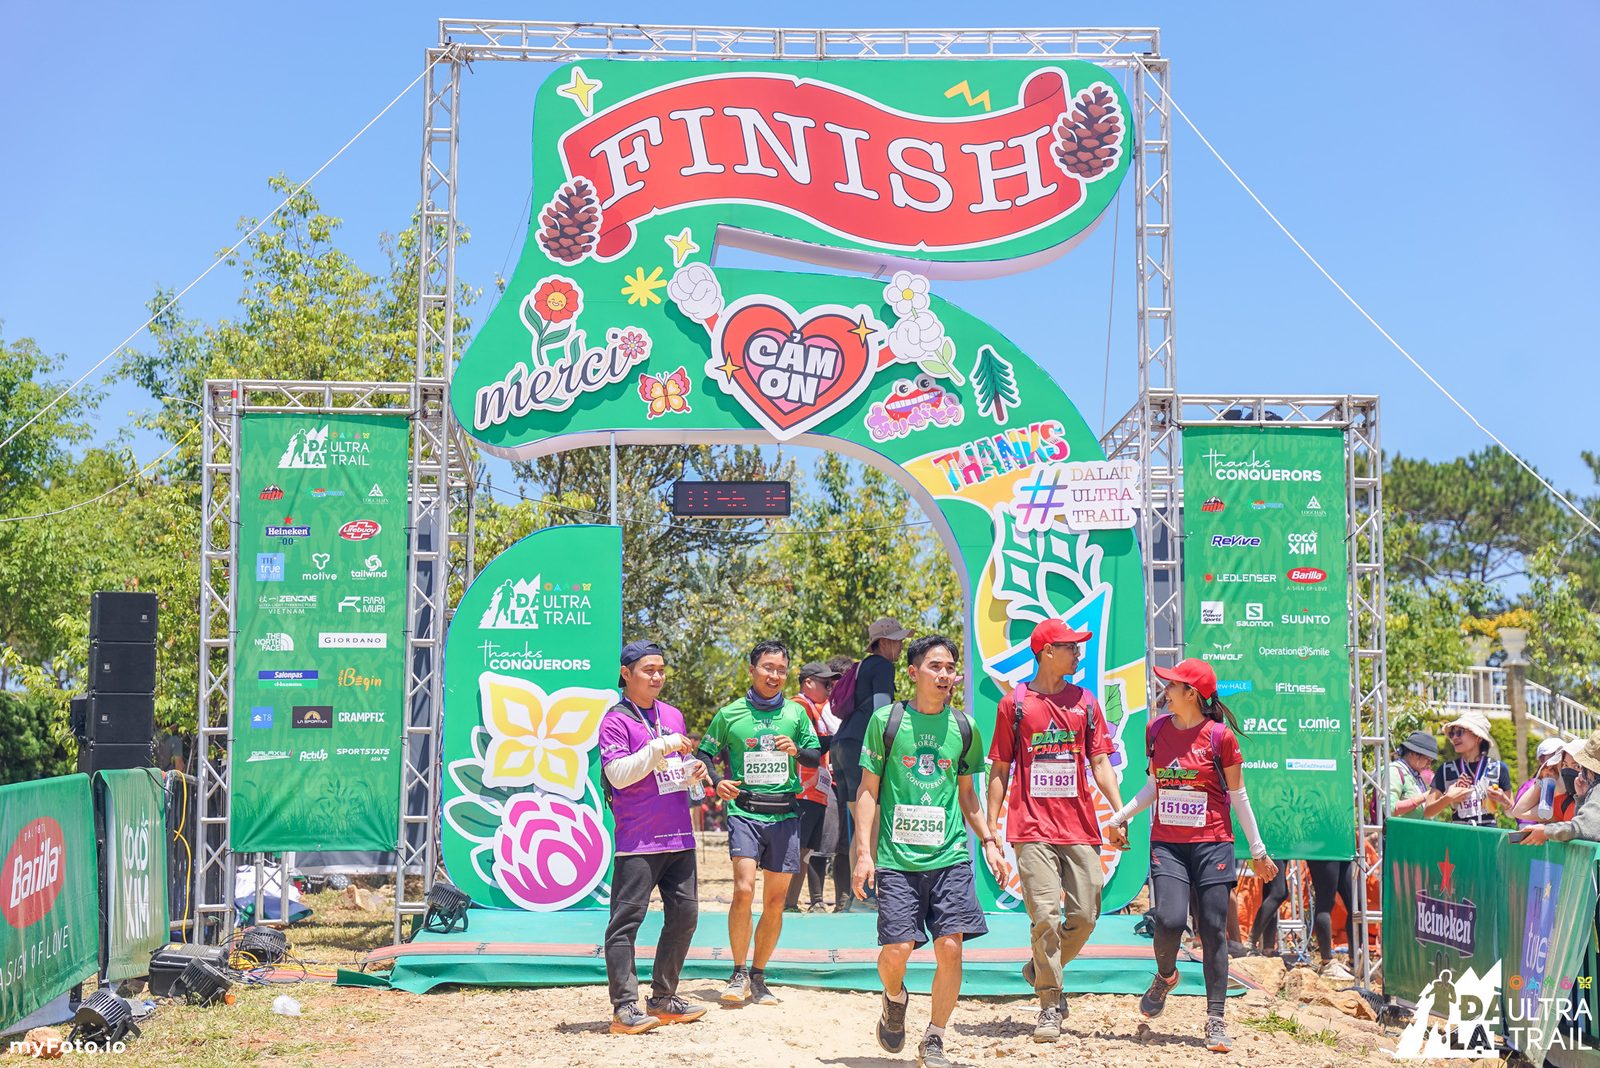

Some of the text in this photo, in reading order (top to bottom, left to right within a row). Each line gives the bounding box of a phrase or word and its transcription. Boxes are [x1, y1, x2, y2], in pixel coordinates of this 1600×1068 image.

[589, 106, 1058, 214] FINISH
[748, 331, 839, 379] CẢM
[479, 332, 634, 426] merci
[330, 441, 370, 453] ULTRA
[331, 454, 370, 466] TRAIL
[933, 422, 1069, 491] THANKS
[1202, 448, 1270, 477] thanks
[1070, 466, 1133, 481] DALAT
[1216, 469, 1322, 482] CONQUERORS
[1072, 488, 1134, 502] ULTRA
[1073, 508, 1130, 523] TRAIL
[268, 527, 308, 536] Heineken
[343, 526, 377, 535] Lifebuoy
[1211, 535, 1261, 547] ReVive
[1288, 543, 1317, 555] XIM
[260, 564, 281, 573] true
[351, 570, 388, 578] tailwind
[302, 572, 337, 580] motive
[1217, 574, 1277, 582] LEDLENSER
[1291, 571, 1322, 580] Barilla
[543, 595, 591, 609] ULTRA
[362, 605, 385, 613] MURI
[543, 611, 591, 625] TRAIL
[1281, 615, 1331, 624] SUUNTO
[477, 639, 542, 666] thanks
[1259, 646, 1330, 657] Operation Smile
[489, 659, 591, 671] CONQUERORS
[274, 671, 303, 679] Salonpas
[1216, 682, 1247, 690] ew-HALE
[338, 712, 385, 722] CRAMPFIX
[1257, 718, 1287, 731] ACC
[912, 740, 944, 751] FOREST
[746, 762, 787, 774] 252329
[1156, 768, 1199, 780] DARE
[906, 771, 947, 789] CONQUEROR
[1033, 774, 1074, 786] 151931
[1160, 801, 1205, 815] 151932
[895, 818, 943, 832] 252354
[10, 837, 60, 909] Barilla
[123, 874, 149, 940] XIM
[1417, 901, 1471, 945] Heineken
[6, 950, 27, 987] SIGN
[31, 938, 43, 969] OF
[46, 925, 69, 960] LOVE
